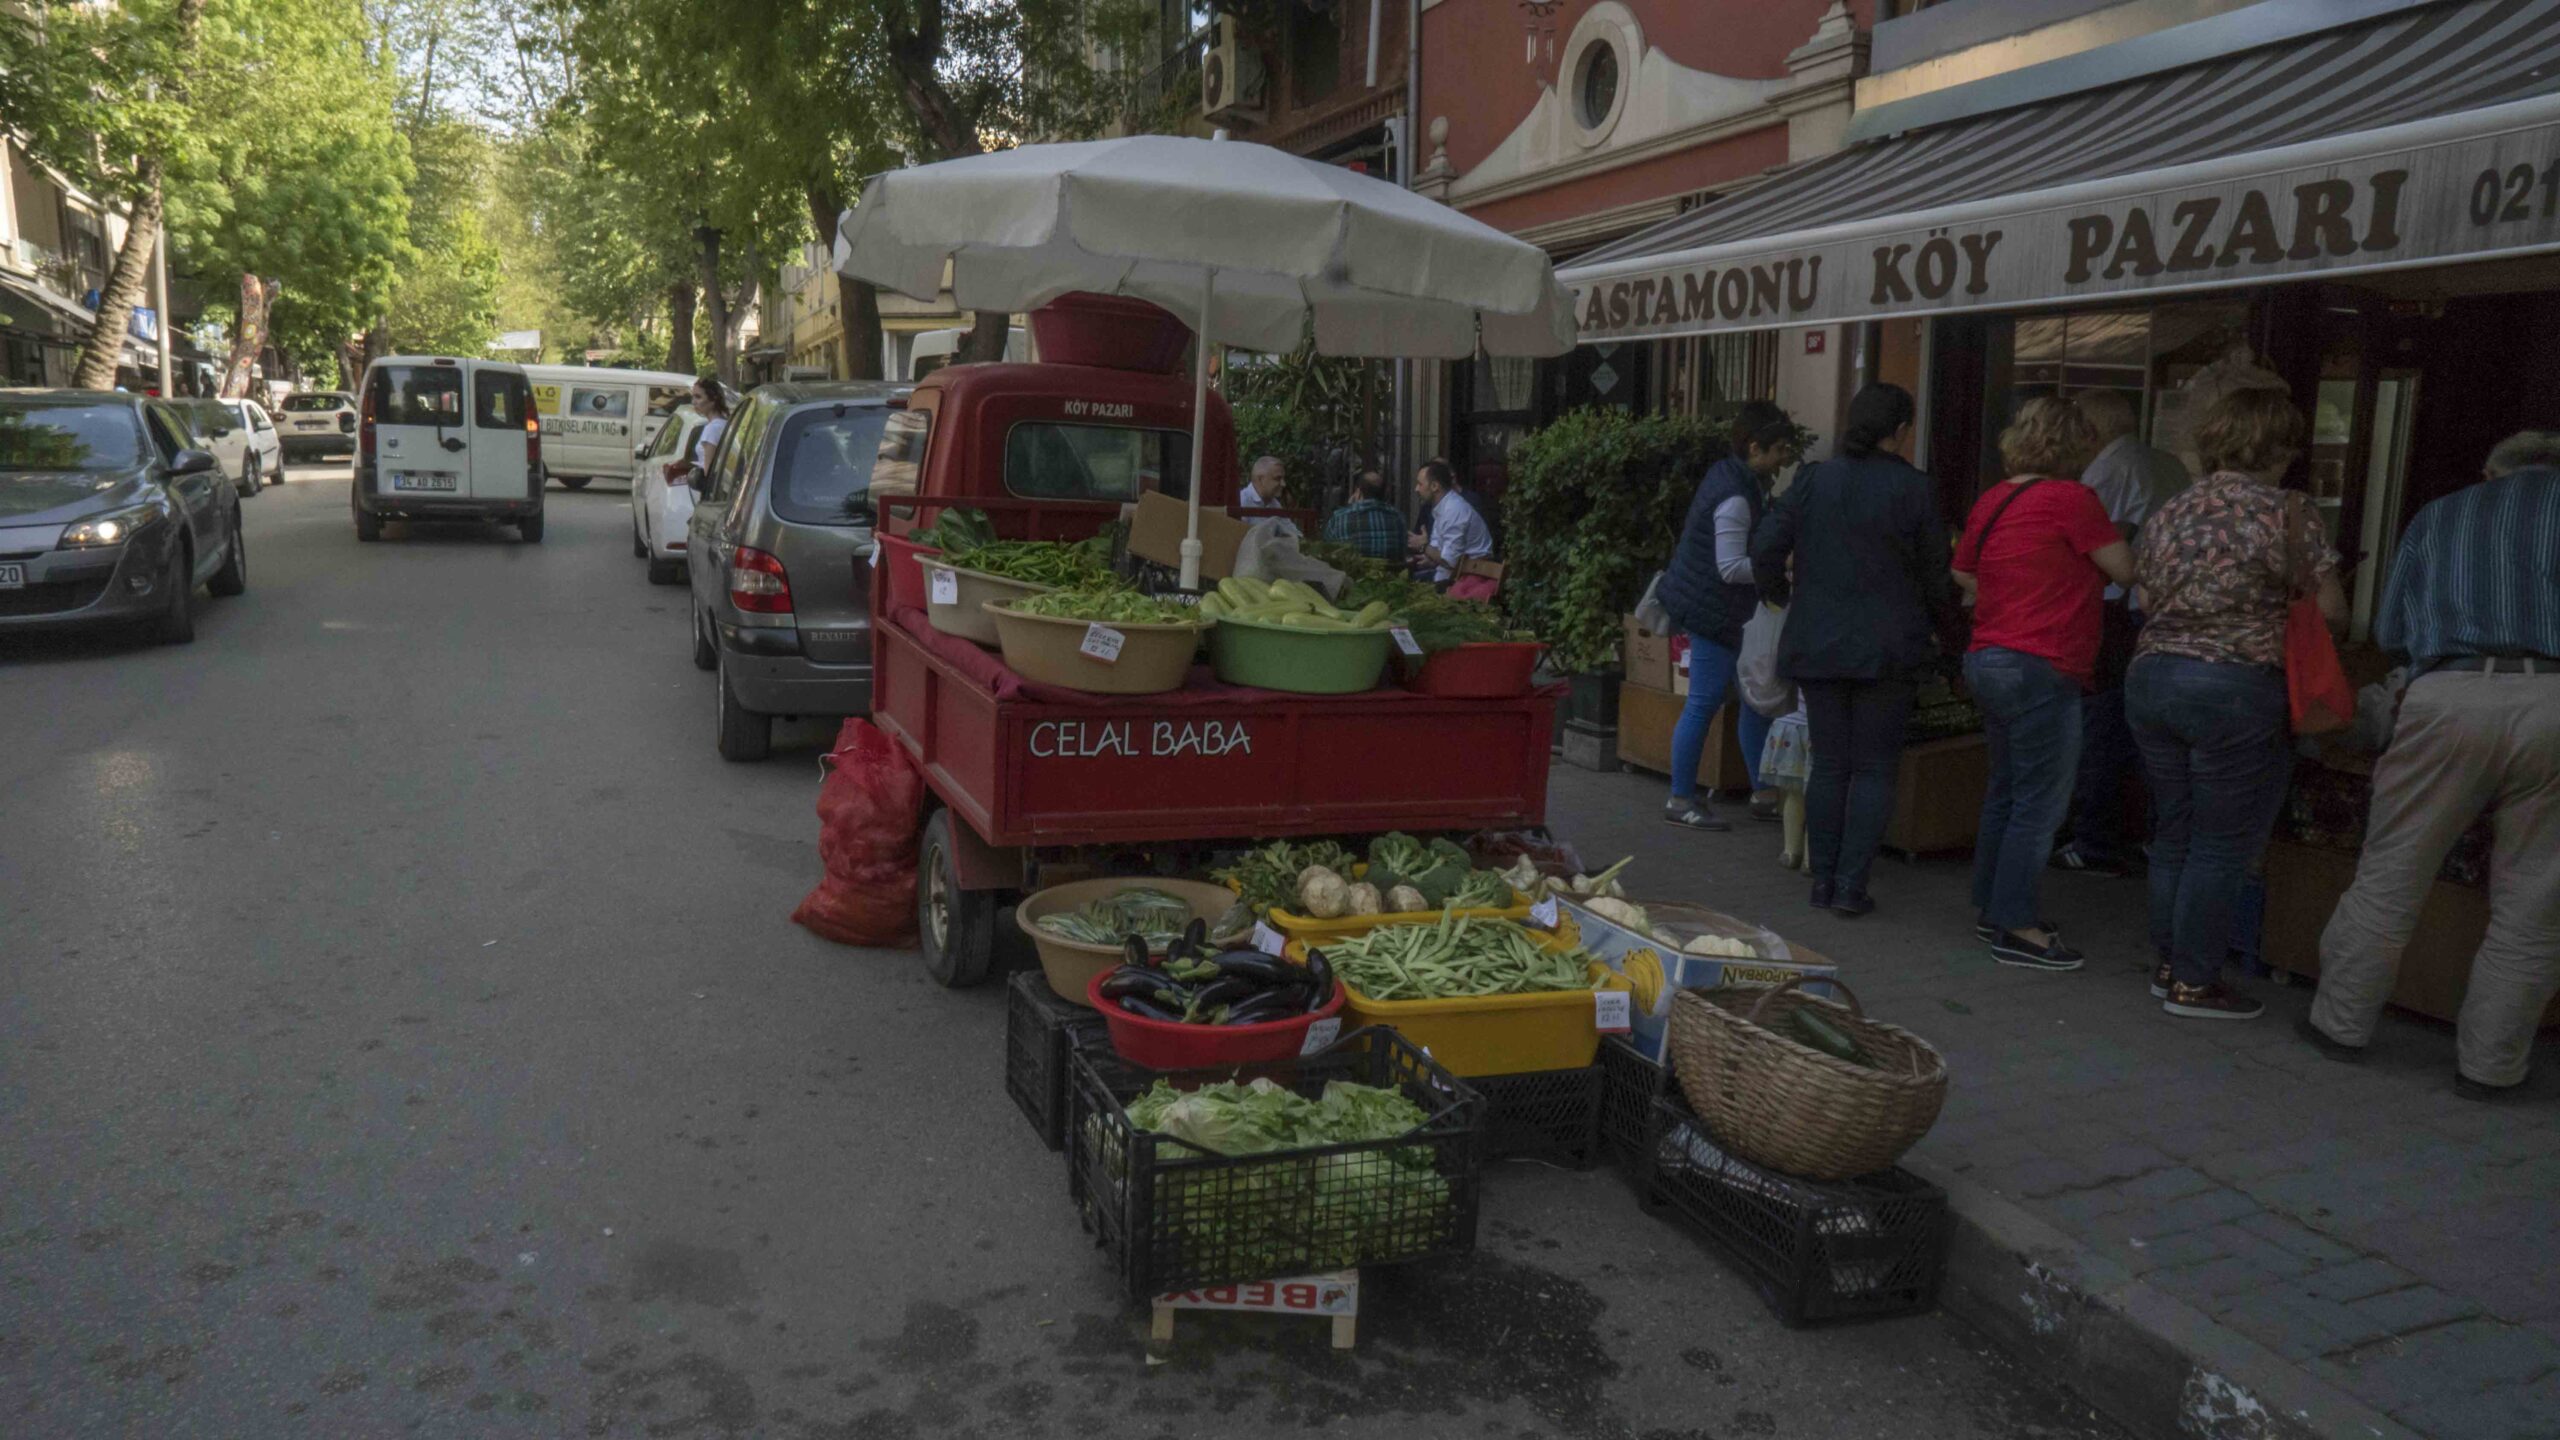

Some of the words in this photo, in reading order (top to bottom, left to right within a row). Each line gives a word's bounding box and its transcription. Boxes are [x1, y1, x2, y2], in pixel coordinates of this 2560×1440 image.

[1870, 228, 2002, 304] KÖY
[2064, 169, 2409, 284] PAZARI
[2470, 158, 2560, 226] 021
[1064, 399, 1088, 415] KÖY
[1091, 402, 1134, 417] PAZARI
[1030, 721, 1139, 757] CELAL
[1152, 721, 1251, 756] BABA
